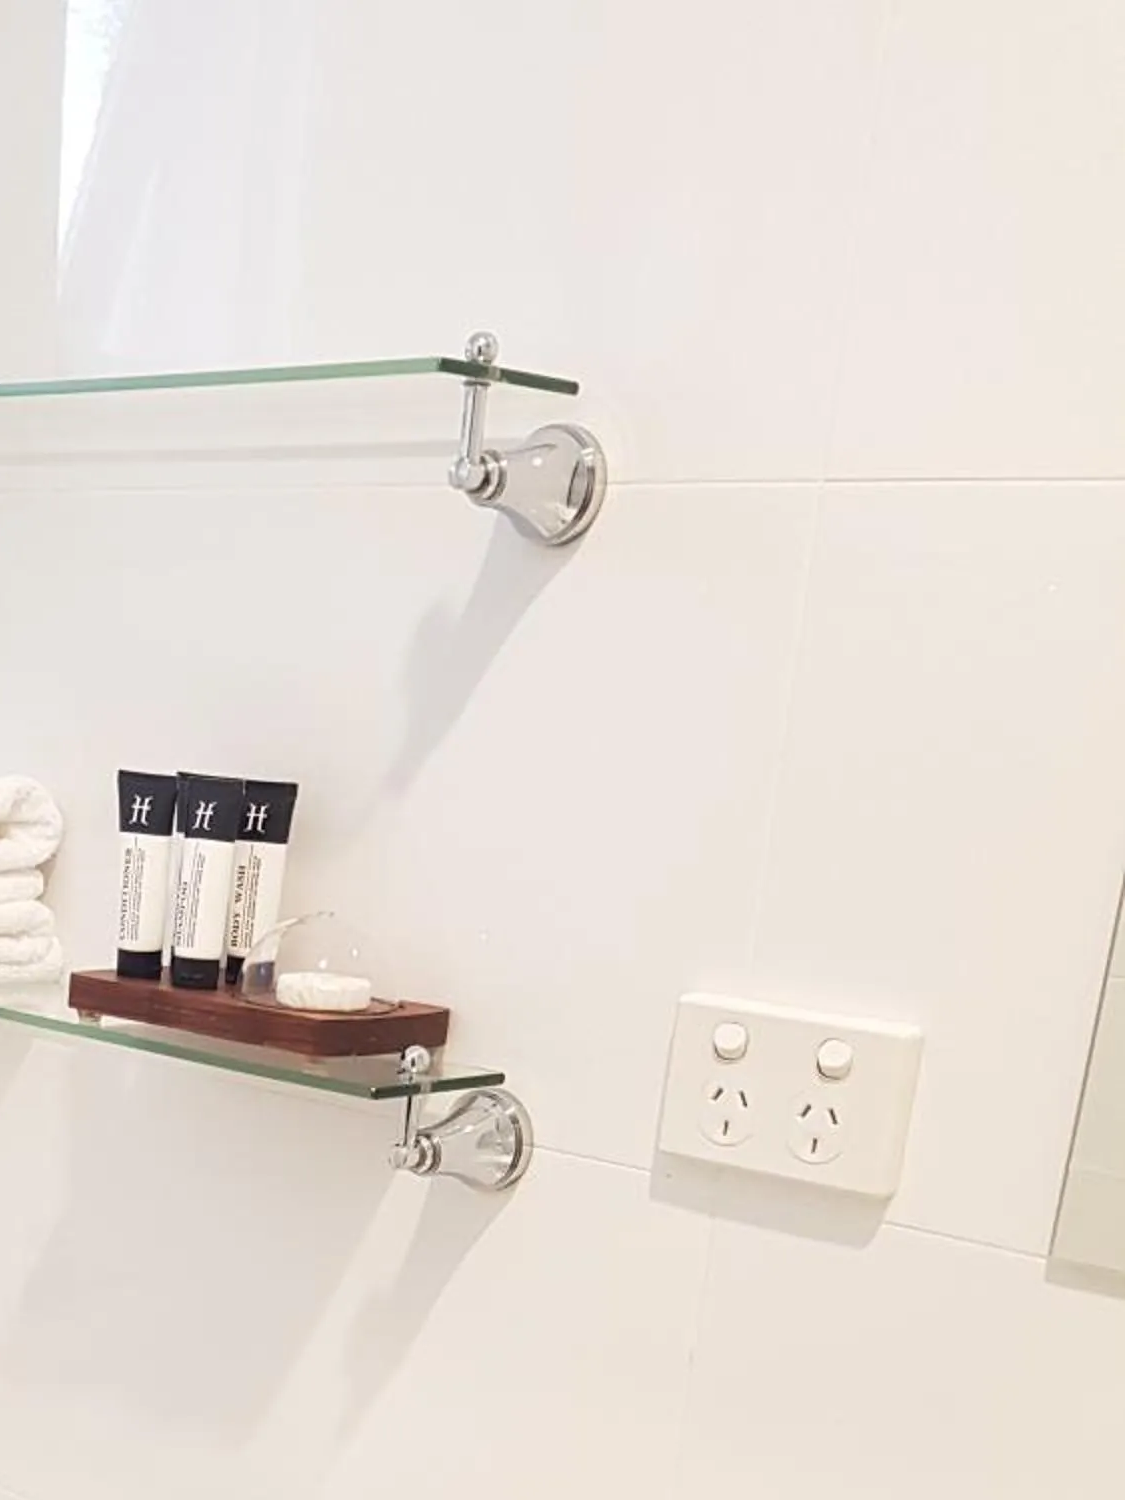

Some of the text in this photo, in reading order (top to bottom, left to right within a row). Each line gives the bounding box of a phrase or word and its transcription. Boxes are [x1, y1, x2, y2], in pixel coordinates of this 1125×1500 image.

[129, 793, 153, 826] H
[192, 800, 217, 831] H
[244, 802, 269, 833] H
[233, 864, 246, 903] WASH
